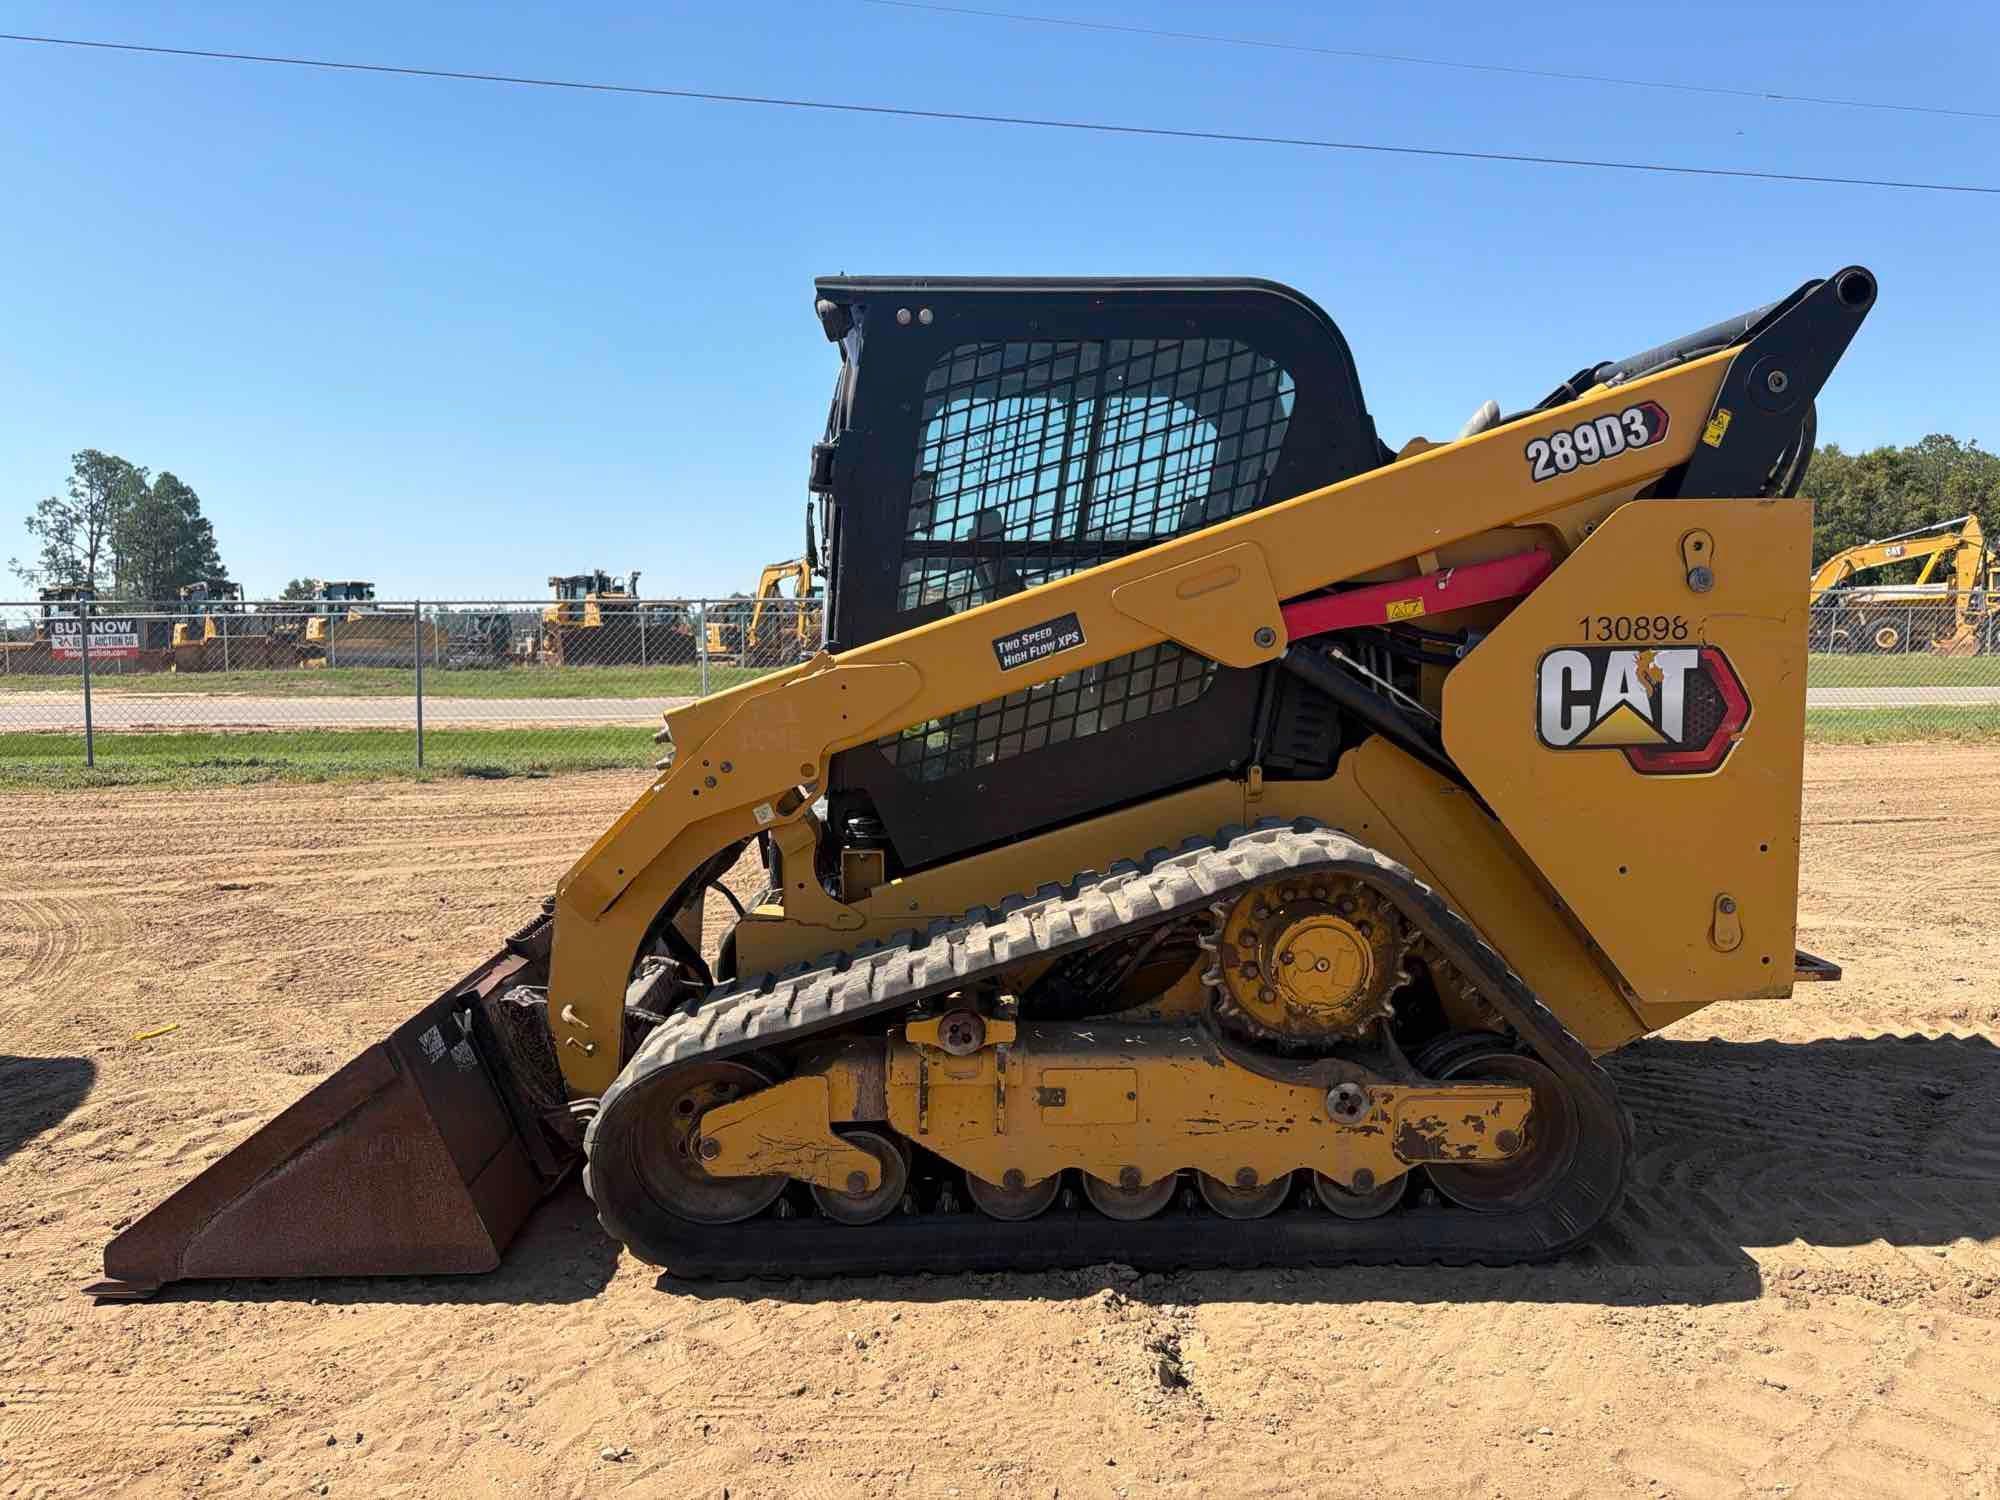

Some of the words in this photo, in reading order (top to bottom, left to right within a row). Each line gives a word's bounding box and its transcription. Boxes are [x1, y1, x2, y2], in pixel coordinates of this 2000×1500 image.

[1526, 408, 1649, 481] 289D3
[91, 621, 132, 633] NOW
[1058, 631, 1079, 648] XPS
[1579, 616, 1688, 641] 130898
[1541, 649, 1698, 746] CAT
